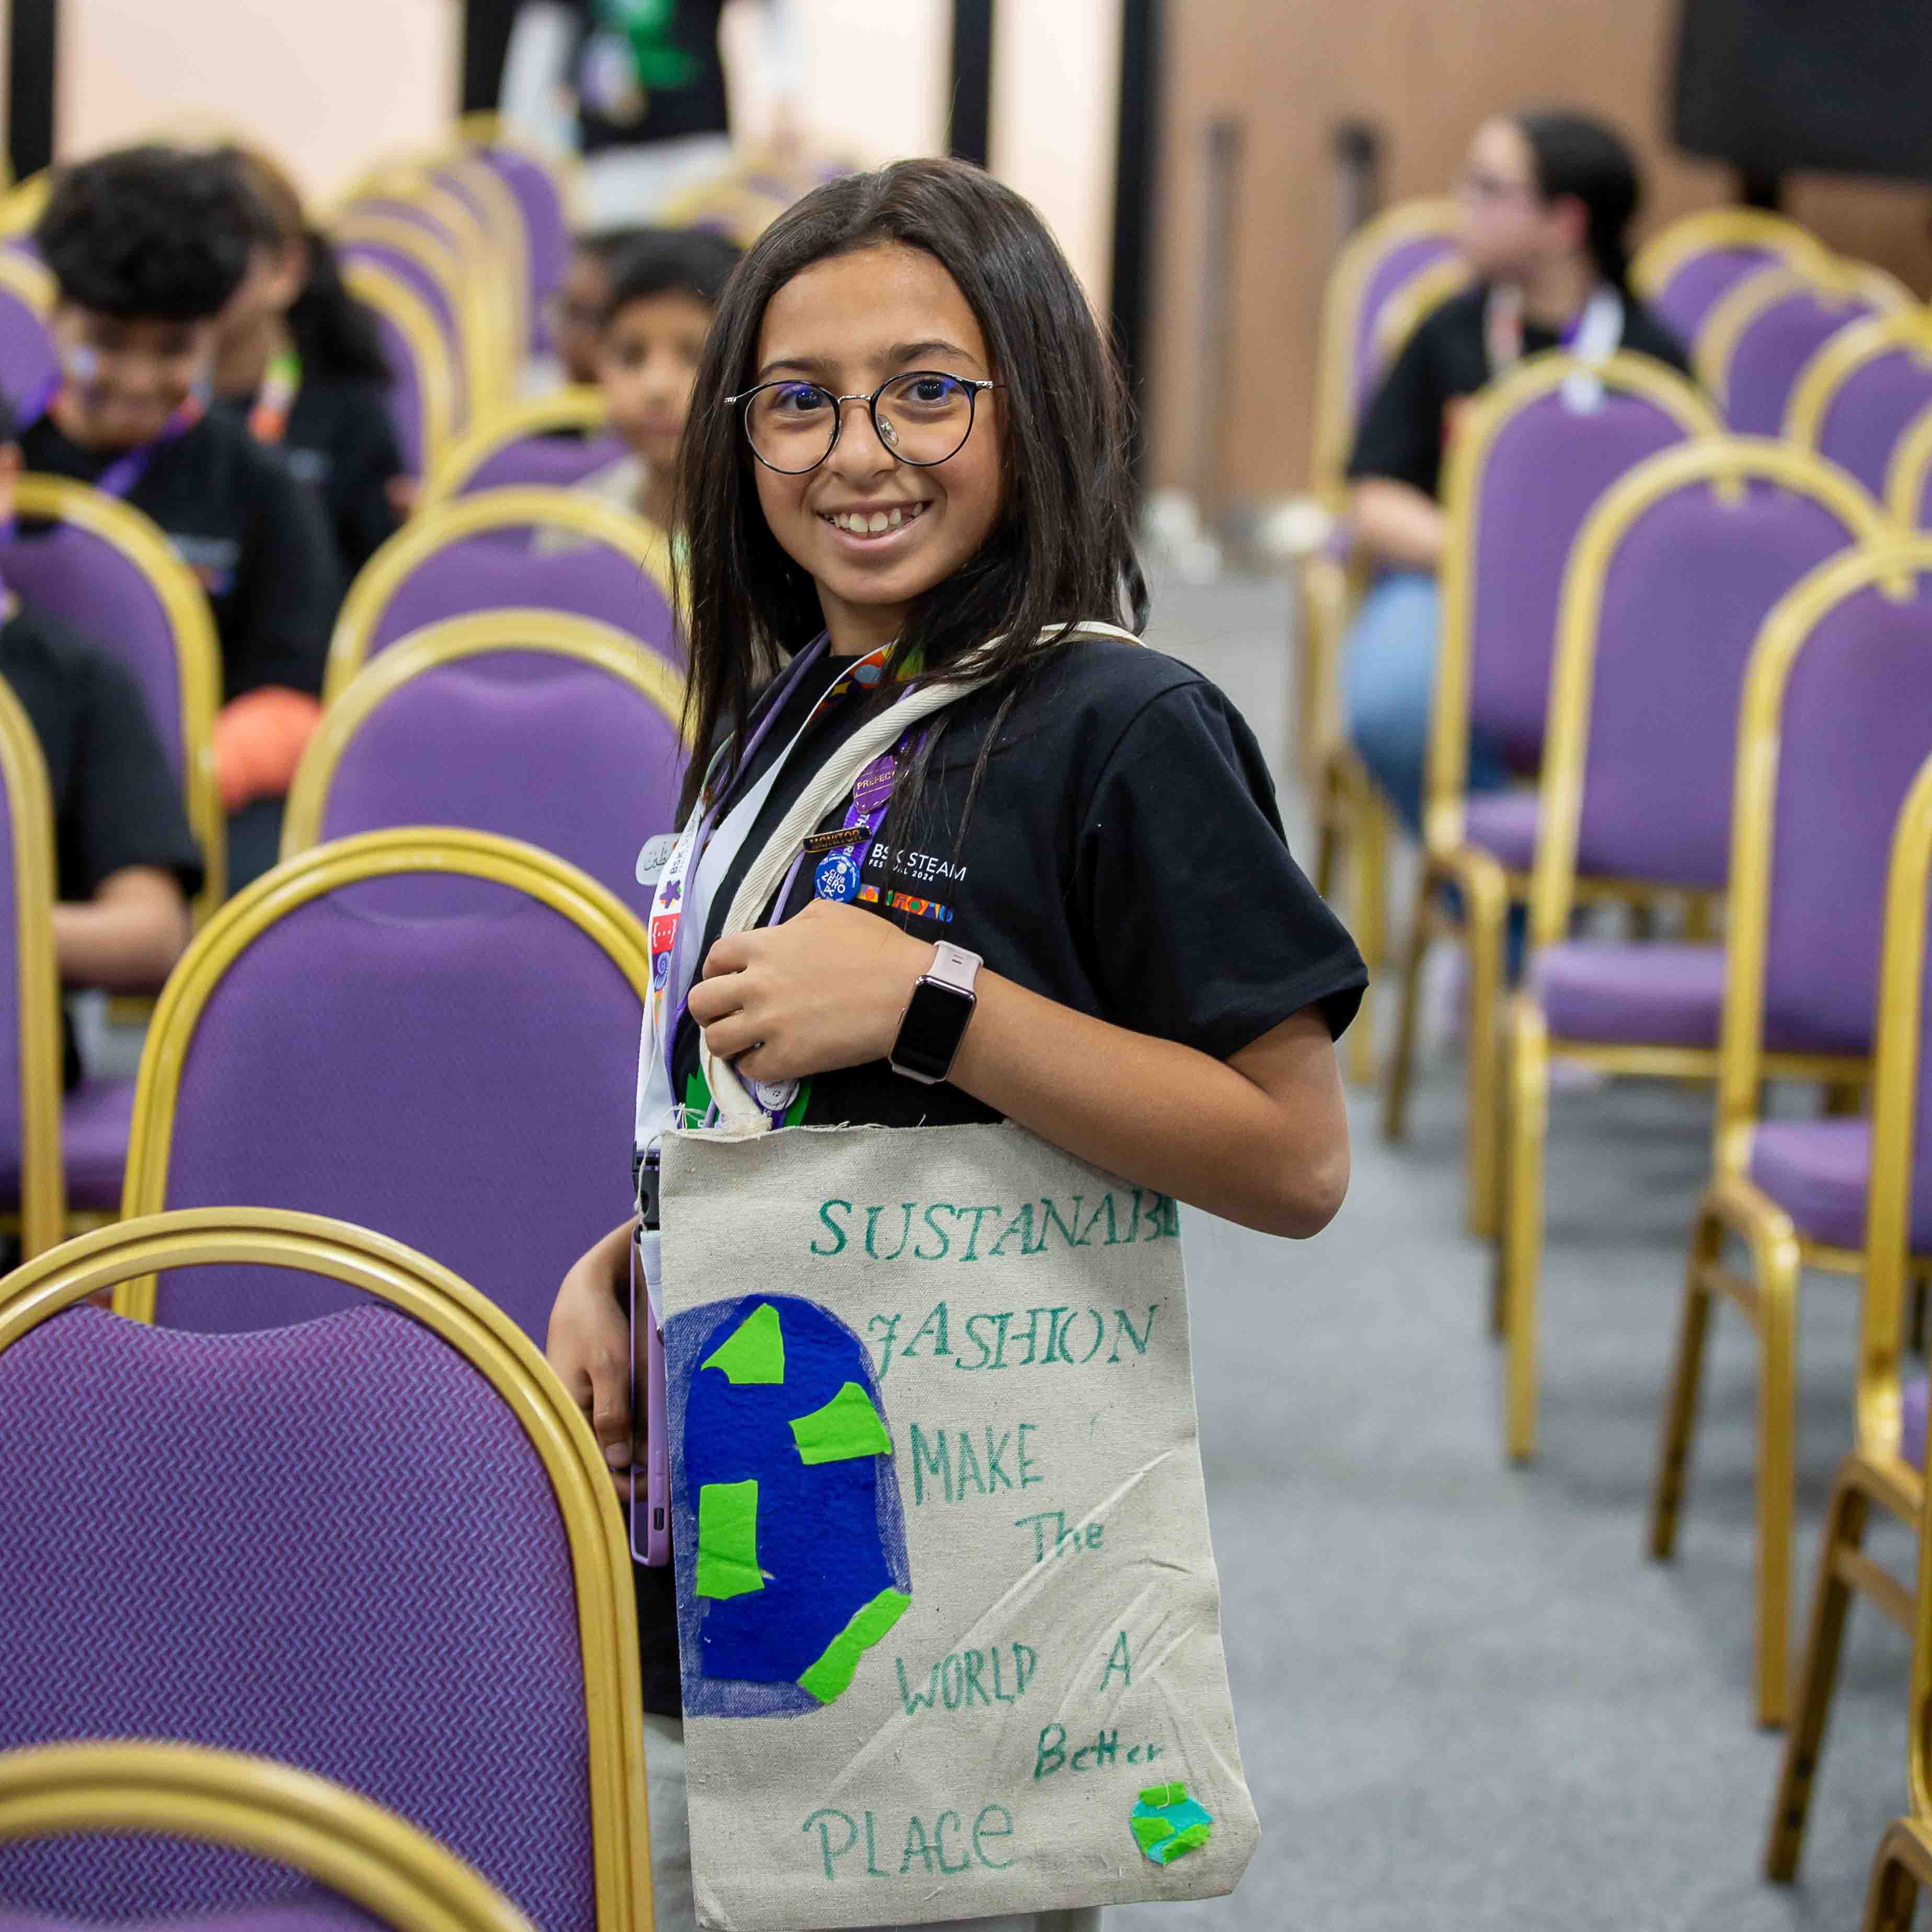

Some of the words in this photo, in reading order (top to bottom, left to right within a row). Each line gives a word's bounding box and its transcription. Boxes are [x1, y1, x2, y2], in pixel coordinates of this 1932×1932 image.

[821, 870, 846, 894] ZERO
[830, 869, 845, 884] CLUB
[907, 852, 967, 882] STEAM
[912, 870, 934, 882] 2024
[868, 1300, 1158, 1383] FASHION
[910, 1421, 1044, 1506] MAKE
[1013, 1511, 1105, 1563] The
[895, 1642, 1037, 1716] WORLD
[1099, 1630, 1132, 1692] A
[1033, 1723, 1164, 1782] Better
